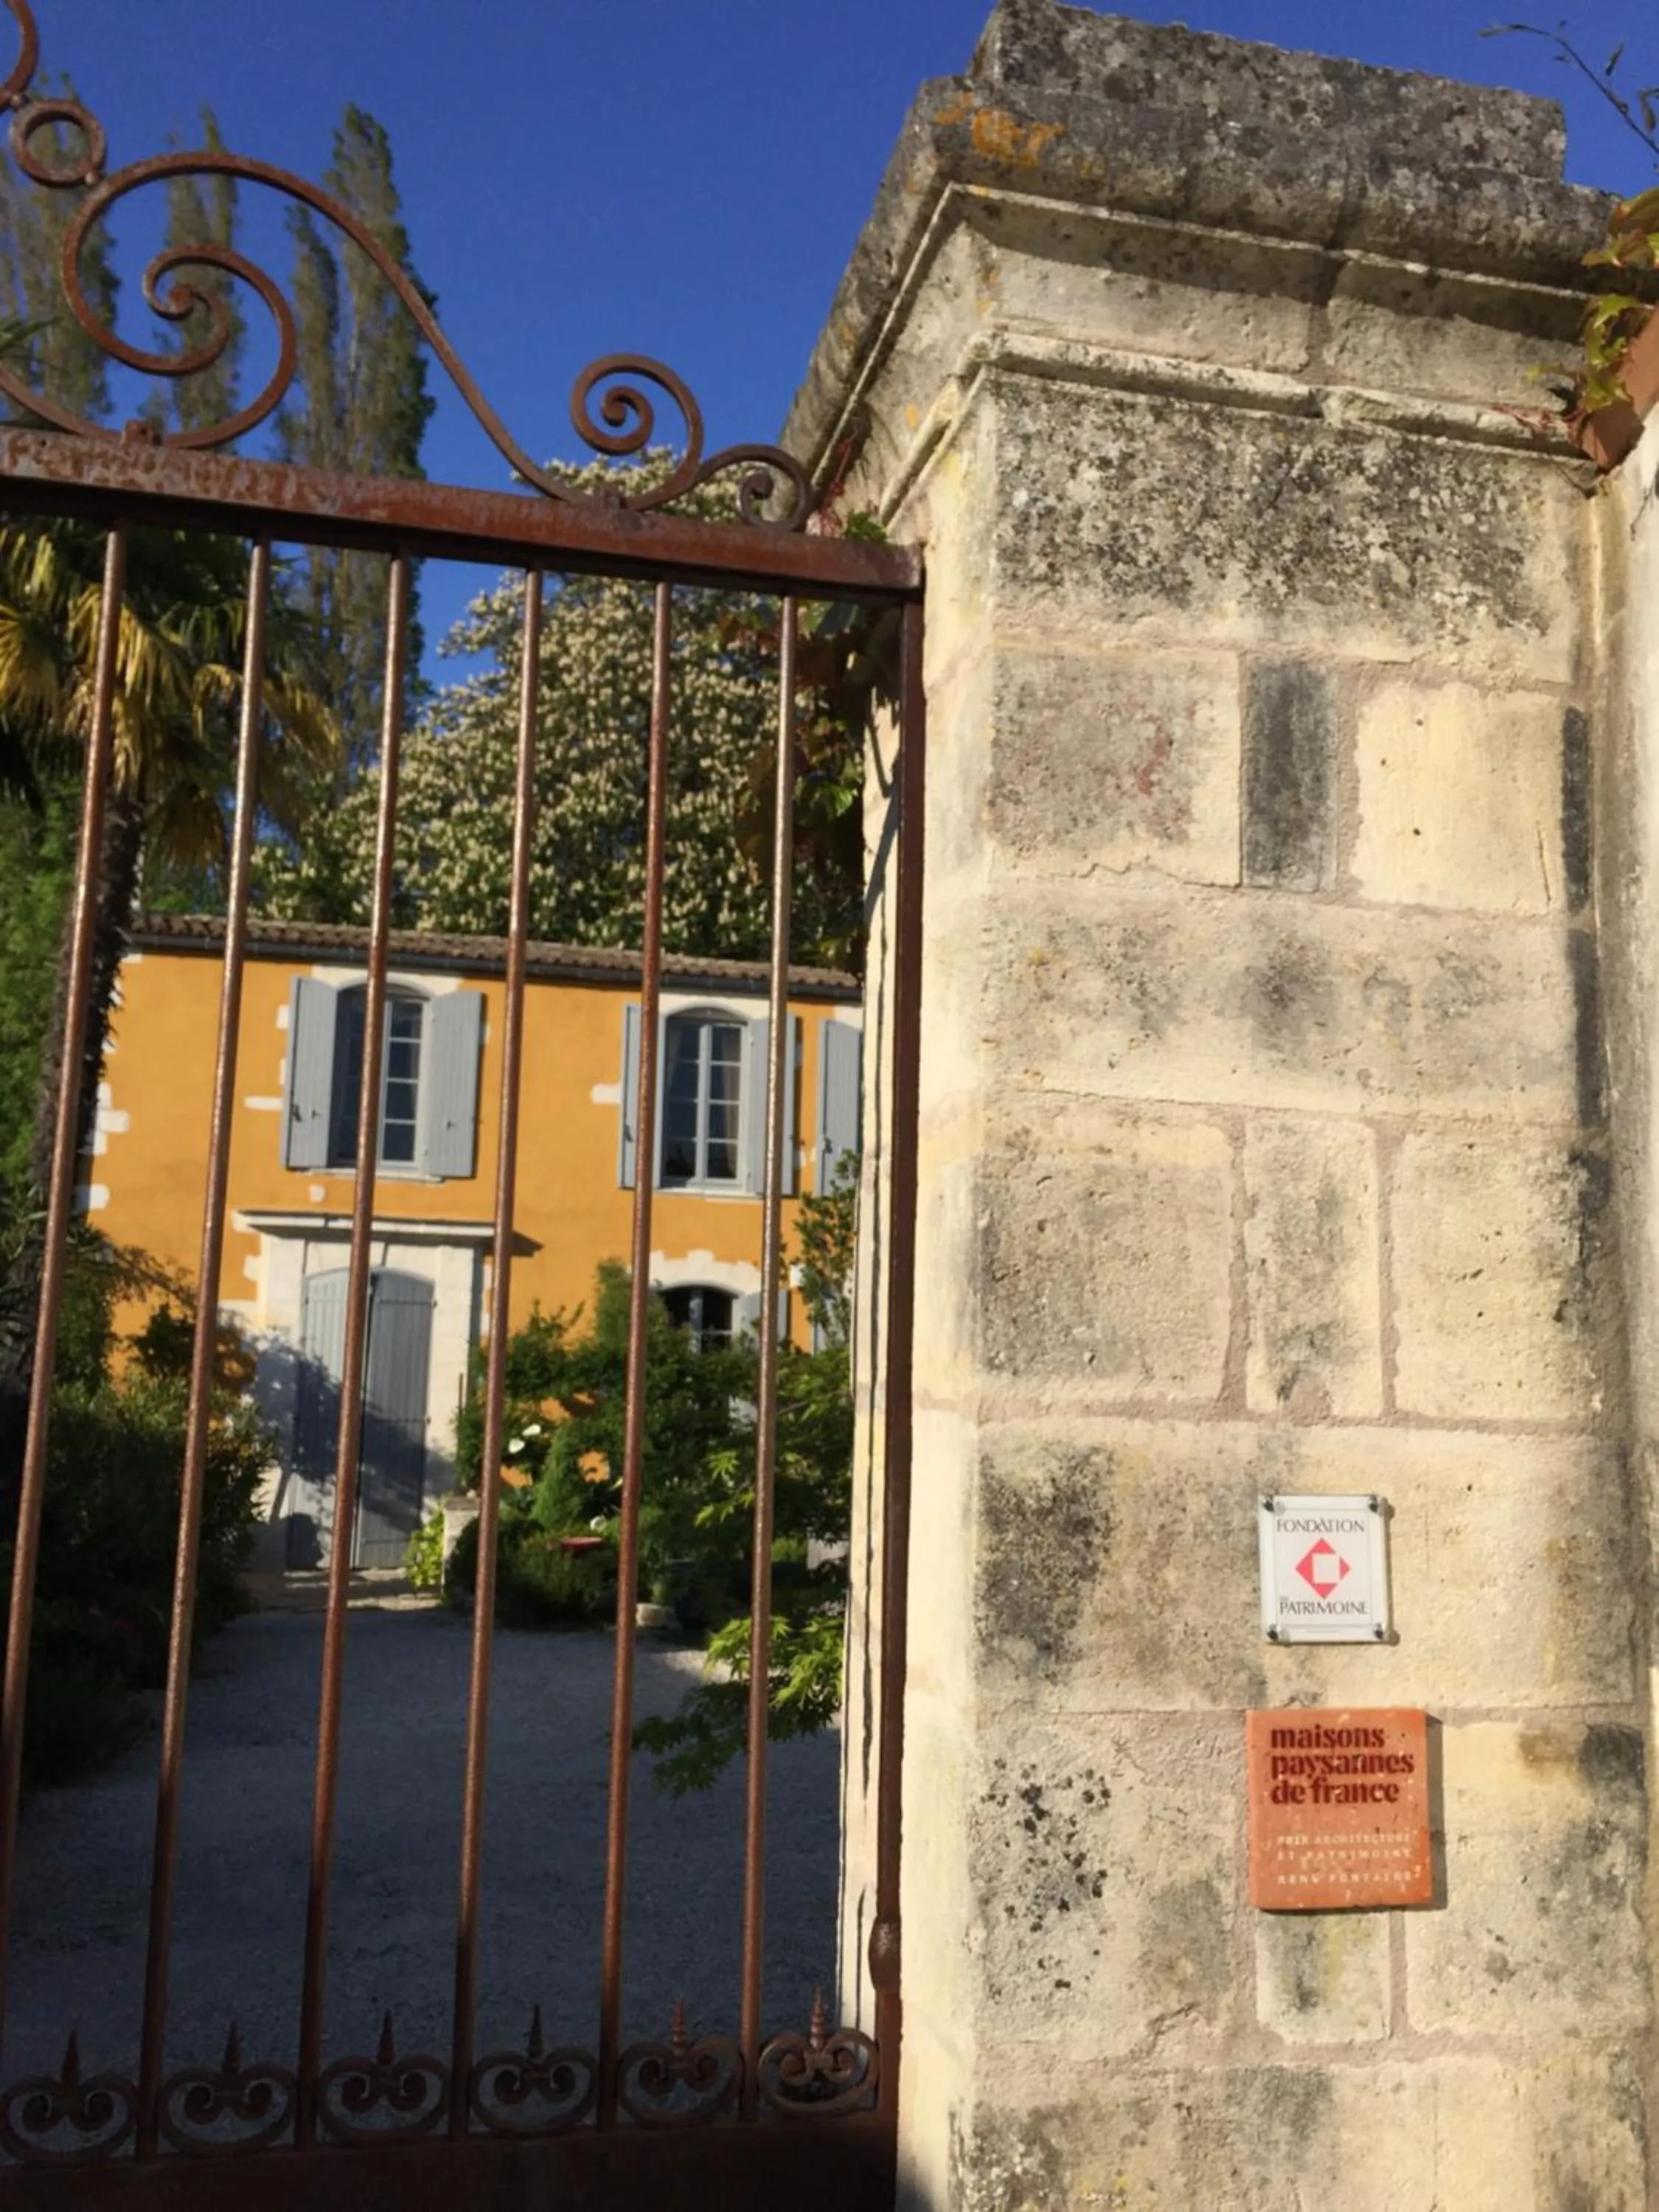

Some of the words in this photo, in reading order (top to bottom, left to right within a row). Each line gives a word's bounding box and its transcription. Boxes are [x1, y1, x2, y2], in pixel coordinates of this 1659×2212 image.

[1276, 1517, 1365, 1532] FONDATION
[1279, 1600, 1368, 1615] PATRIMOINE
[1270, 1723, 1385, 1749] maisons
[1270, 1753, 1415, 1781] paysannes
[1270, 1781, 1306, 1804] de
[1310, 1775, 1400, 1804] france
[1277, 1835, 1309, 1845] PRIX
